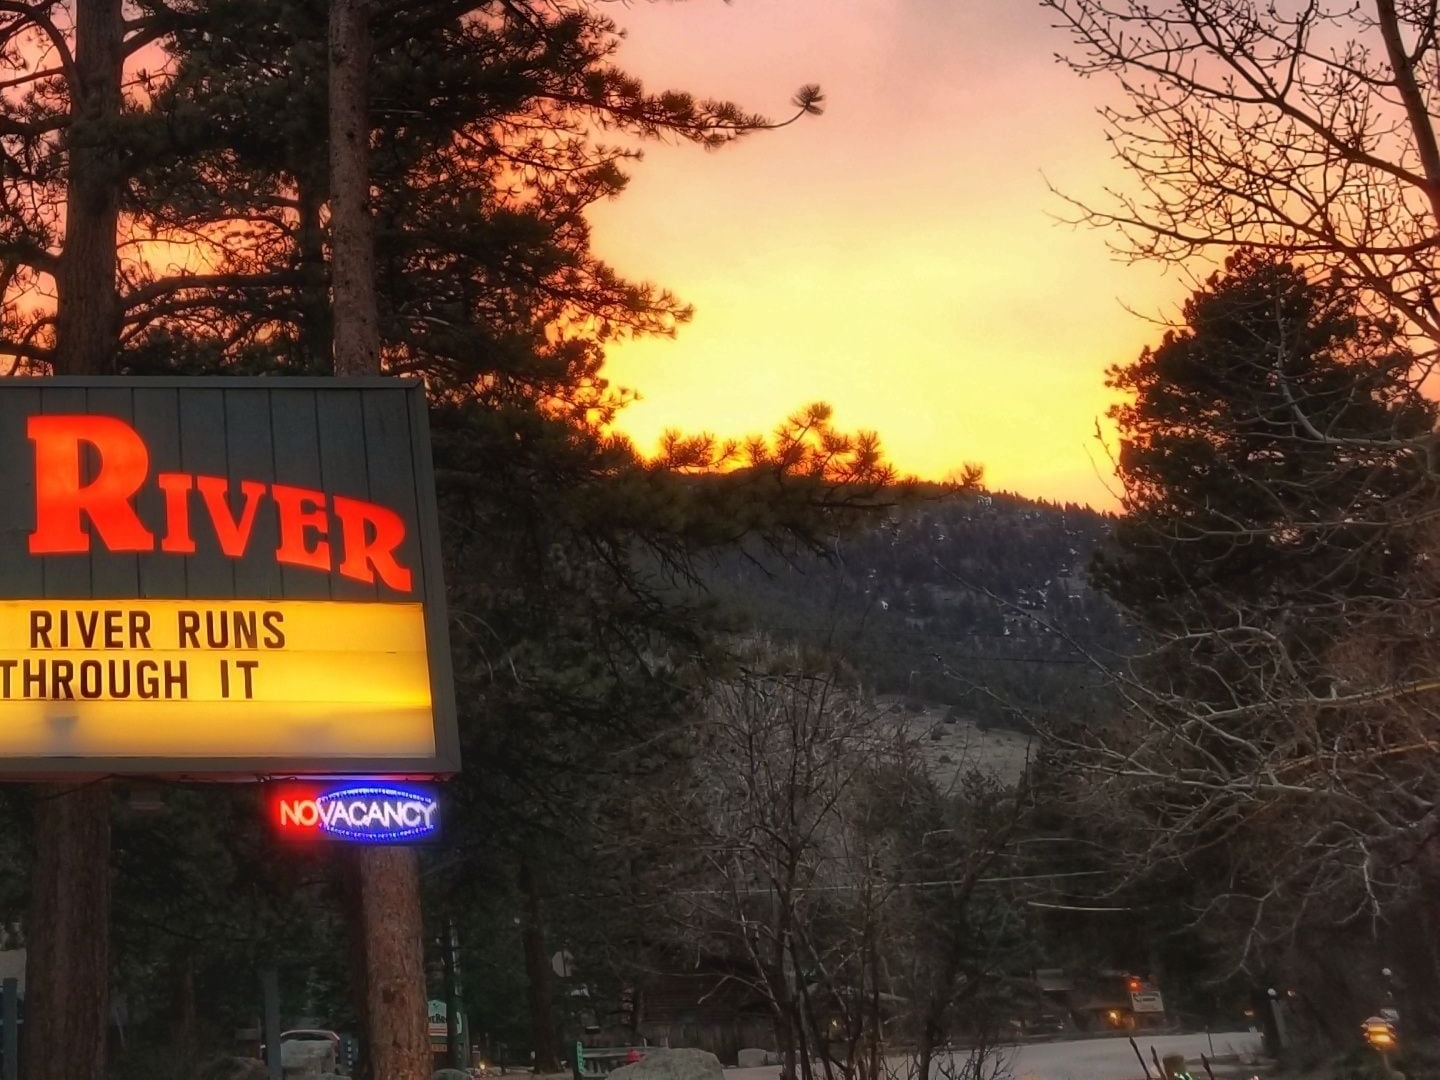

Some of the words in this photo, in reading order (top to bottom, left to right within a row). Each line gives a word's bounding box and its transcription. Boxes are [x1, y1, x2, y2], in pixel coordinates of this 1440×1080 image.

[26, 414, 412, 594] RIVER
[30, 610, 151, 649] RIVER
[178, 610, 286, 649] RUNS
[220, 659, 259, 699] IT
[279, 799, 319, 827] NO
[315, 800, 437, 828] VACANCY
